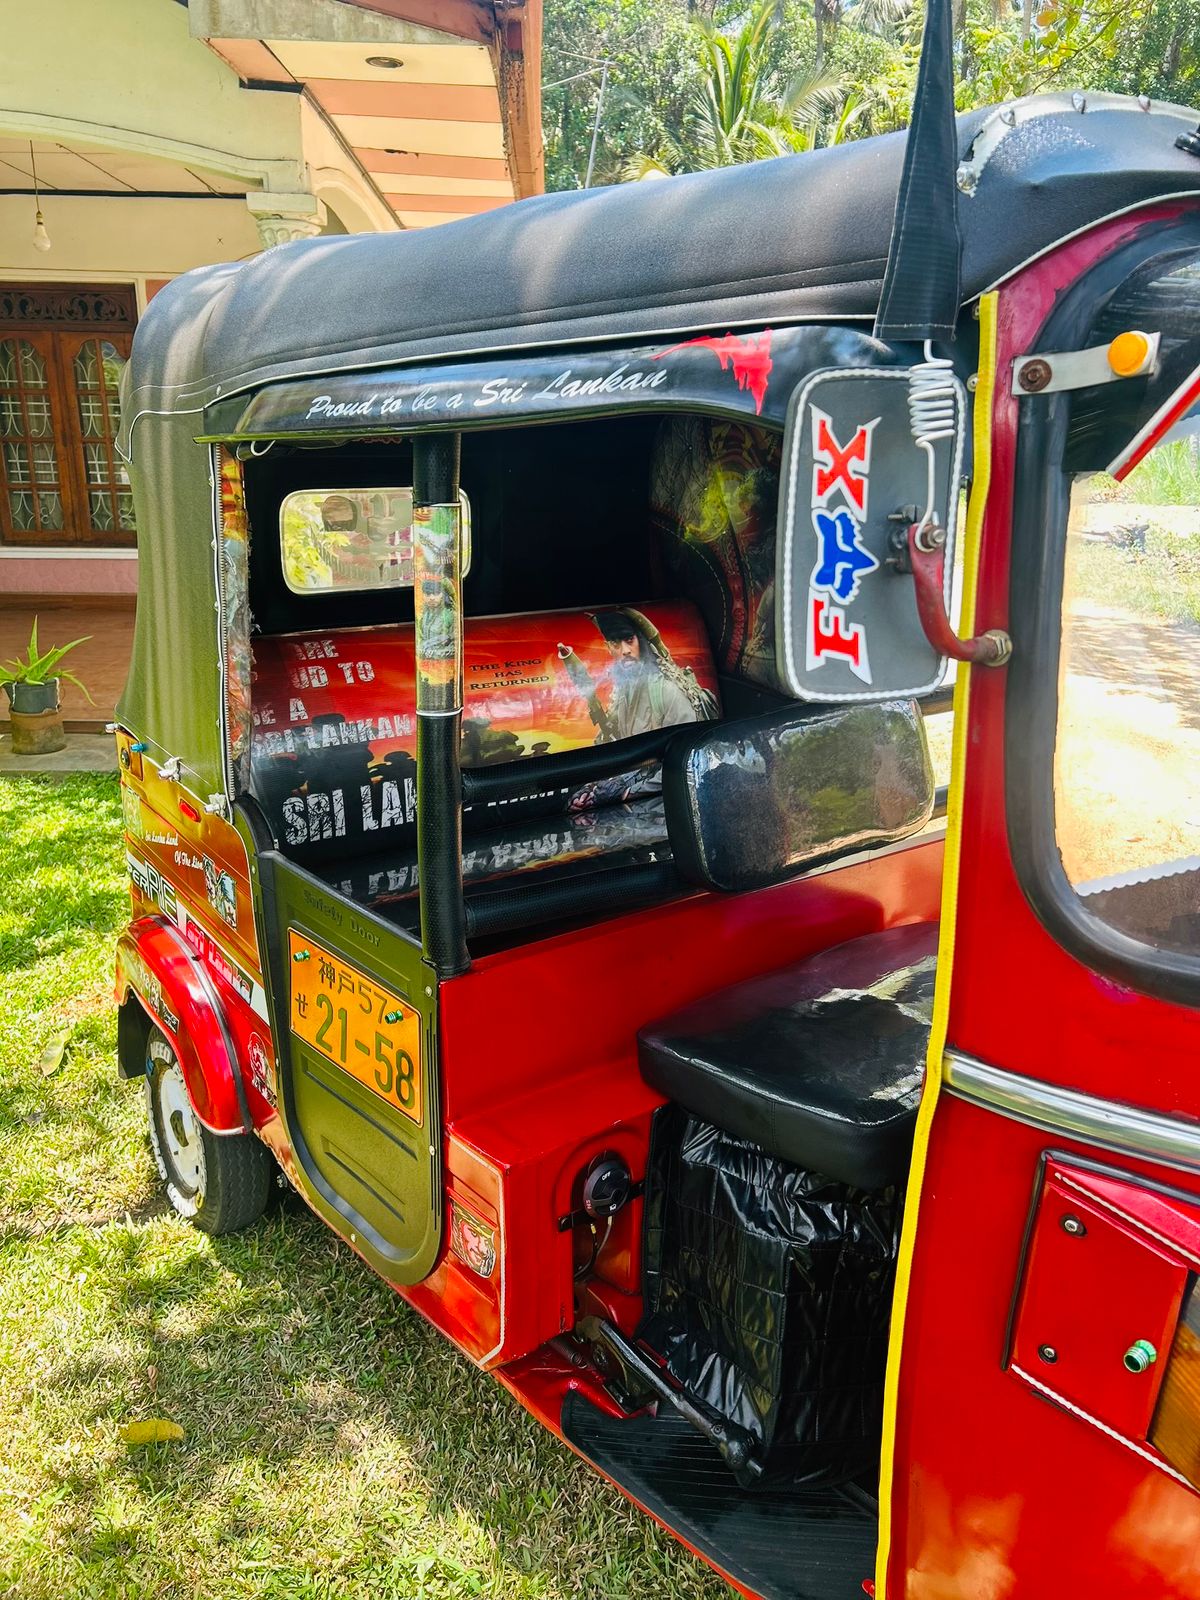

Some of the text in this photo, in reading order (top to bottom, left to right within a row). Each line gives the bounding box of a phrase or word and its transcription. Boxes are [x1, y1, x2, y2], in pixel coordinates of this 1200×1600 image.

[306, 363, 668, 420] Proud to be a Sri Lankan
[338, 661, 376, 684] TO
[469, 659, 542, 672] THE KING
[495, 669, 522, 678] HAS
[470, 675, 550, 690] RETURNED
[304, 714, 413, 750] LANKAN
[282, 788, 347, 846] SRI
[295, 992, 309, 1020] せ
[316, 993, 416, 1110] 21-58
